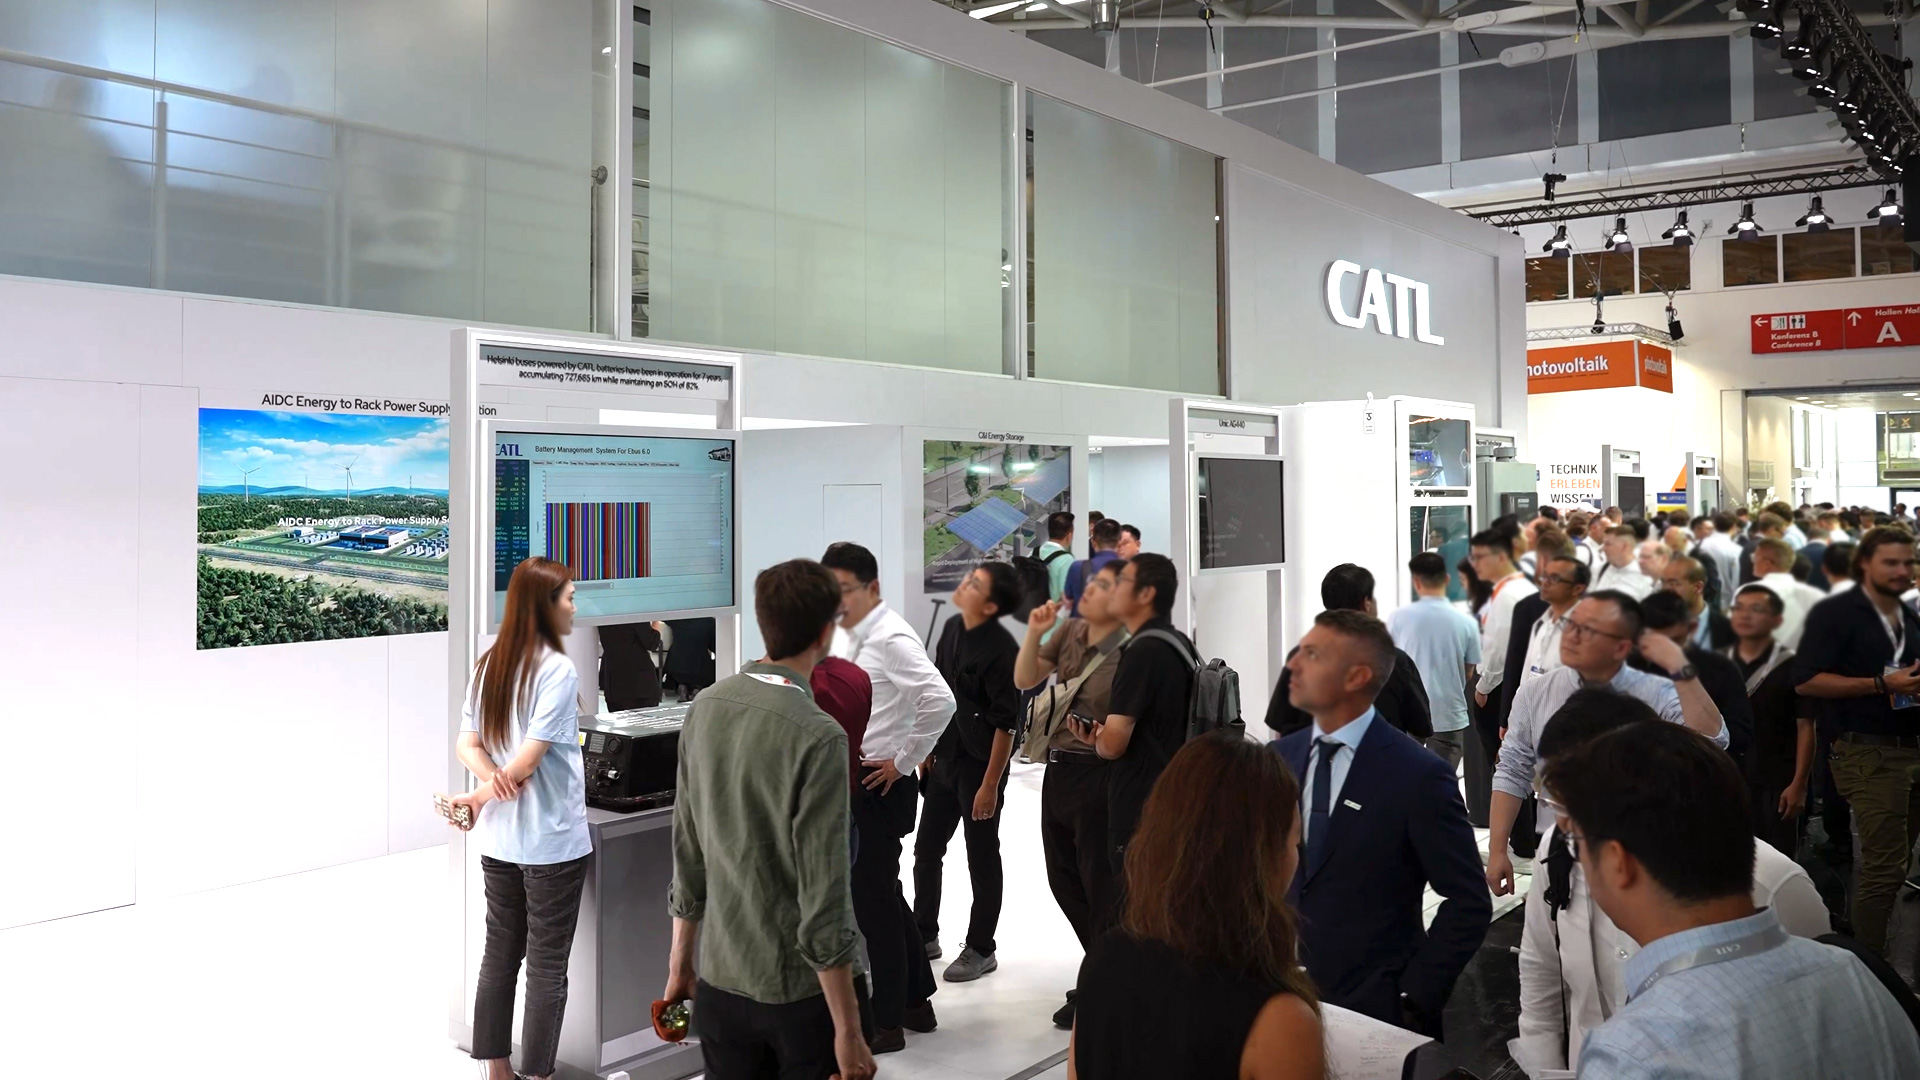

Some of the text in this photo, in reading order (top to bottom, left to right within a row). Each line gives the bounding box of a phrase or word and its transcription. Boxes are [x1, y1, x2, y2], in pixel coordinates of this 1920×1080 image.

[1325, 259, 1444, 346] CATL
[1905, 306, 1920, 315] Hal
[1771, 333, 1810, 341] Konferenz
[1876, 321, 1902, 343] A
[1771, 339, 1821, 349] Conference B
[487, 354, 514, 366] Helsinki
[515, 357, 536, 368] buses
[537, 360, 567, 369] powered
[568, 361, 576, 371] by
[577, 362, 594, 371] CATL
[596, 363, 625, 375] batteries
[625, 366, 640, 375] have
[641, 367, 657, 376] been
[664, 370, 692, 379] operation
[692, 371, 701, 379] for
[1527, 355, 1608, 377] otovoltaik
[519, 370, 564, 382] accumulating
[603, 376, 619, 384] while
[619, 378, 655, 389] maintaining
[663, 380, 677, 388] SOH
[679, 381, 685, 389] of
[262, 394, 293, 407] AIDC
[296, 396, 337, 411] Energy
[340, 398, 352, 409] to
[354, 399, 382, 411] Rack
[384, 401, 417, 413] Power
[988, 432, 1005, 441] Energy
[1005, 433, 1024, 442] Storage
[535, 445, 555, 454] Battery
[557, 446, 593, 455] Management
[596, 447, 616, 455] System
[1550, 464, 1598, 474] TECHNIK
[1550, 479, 1600, 488] ERLEBEN
[277, 517, 303, 526] AIDC
[305, 517, 340, 528] Energy
[342, 517, 352, 526] to
[354, 516, 377, 526] Rack
[379, 516, 408, 525] Power
[409, 515, 440, 526] Supply
[1715, 944, 1740, 955] CATL
